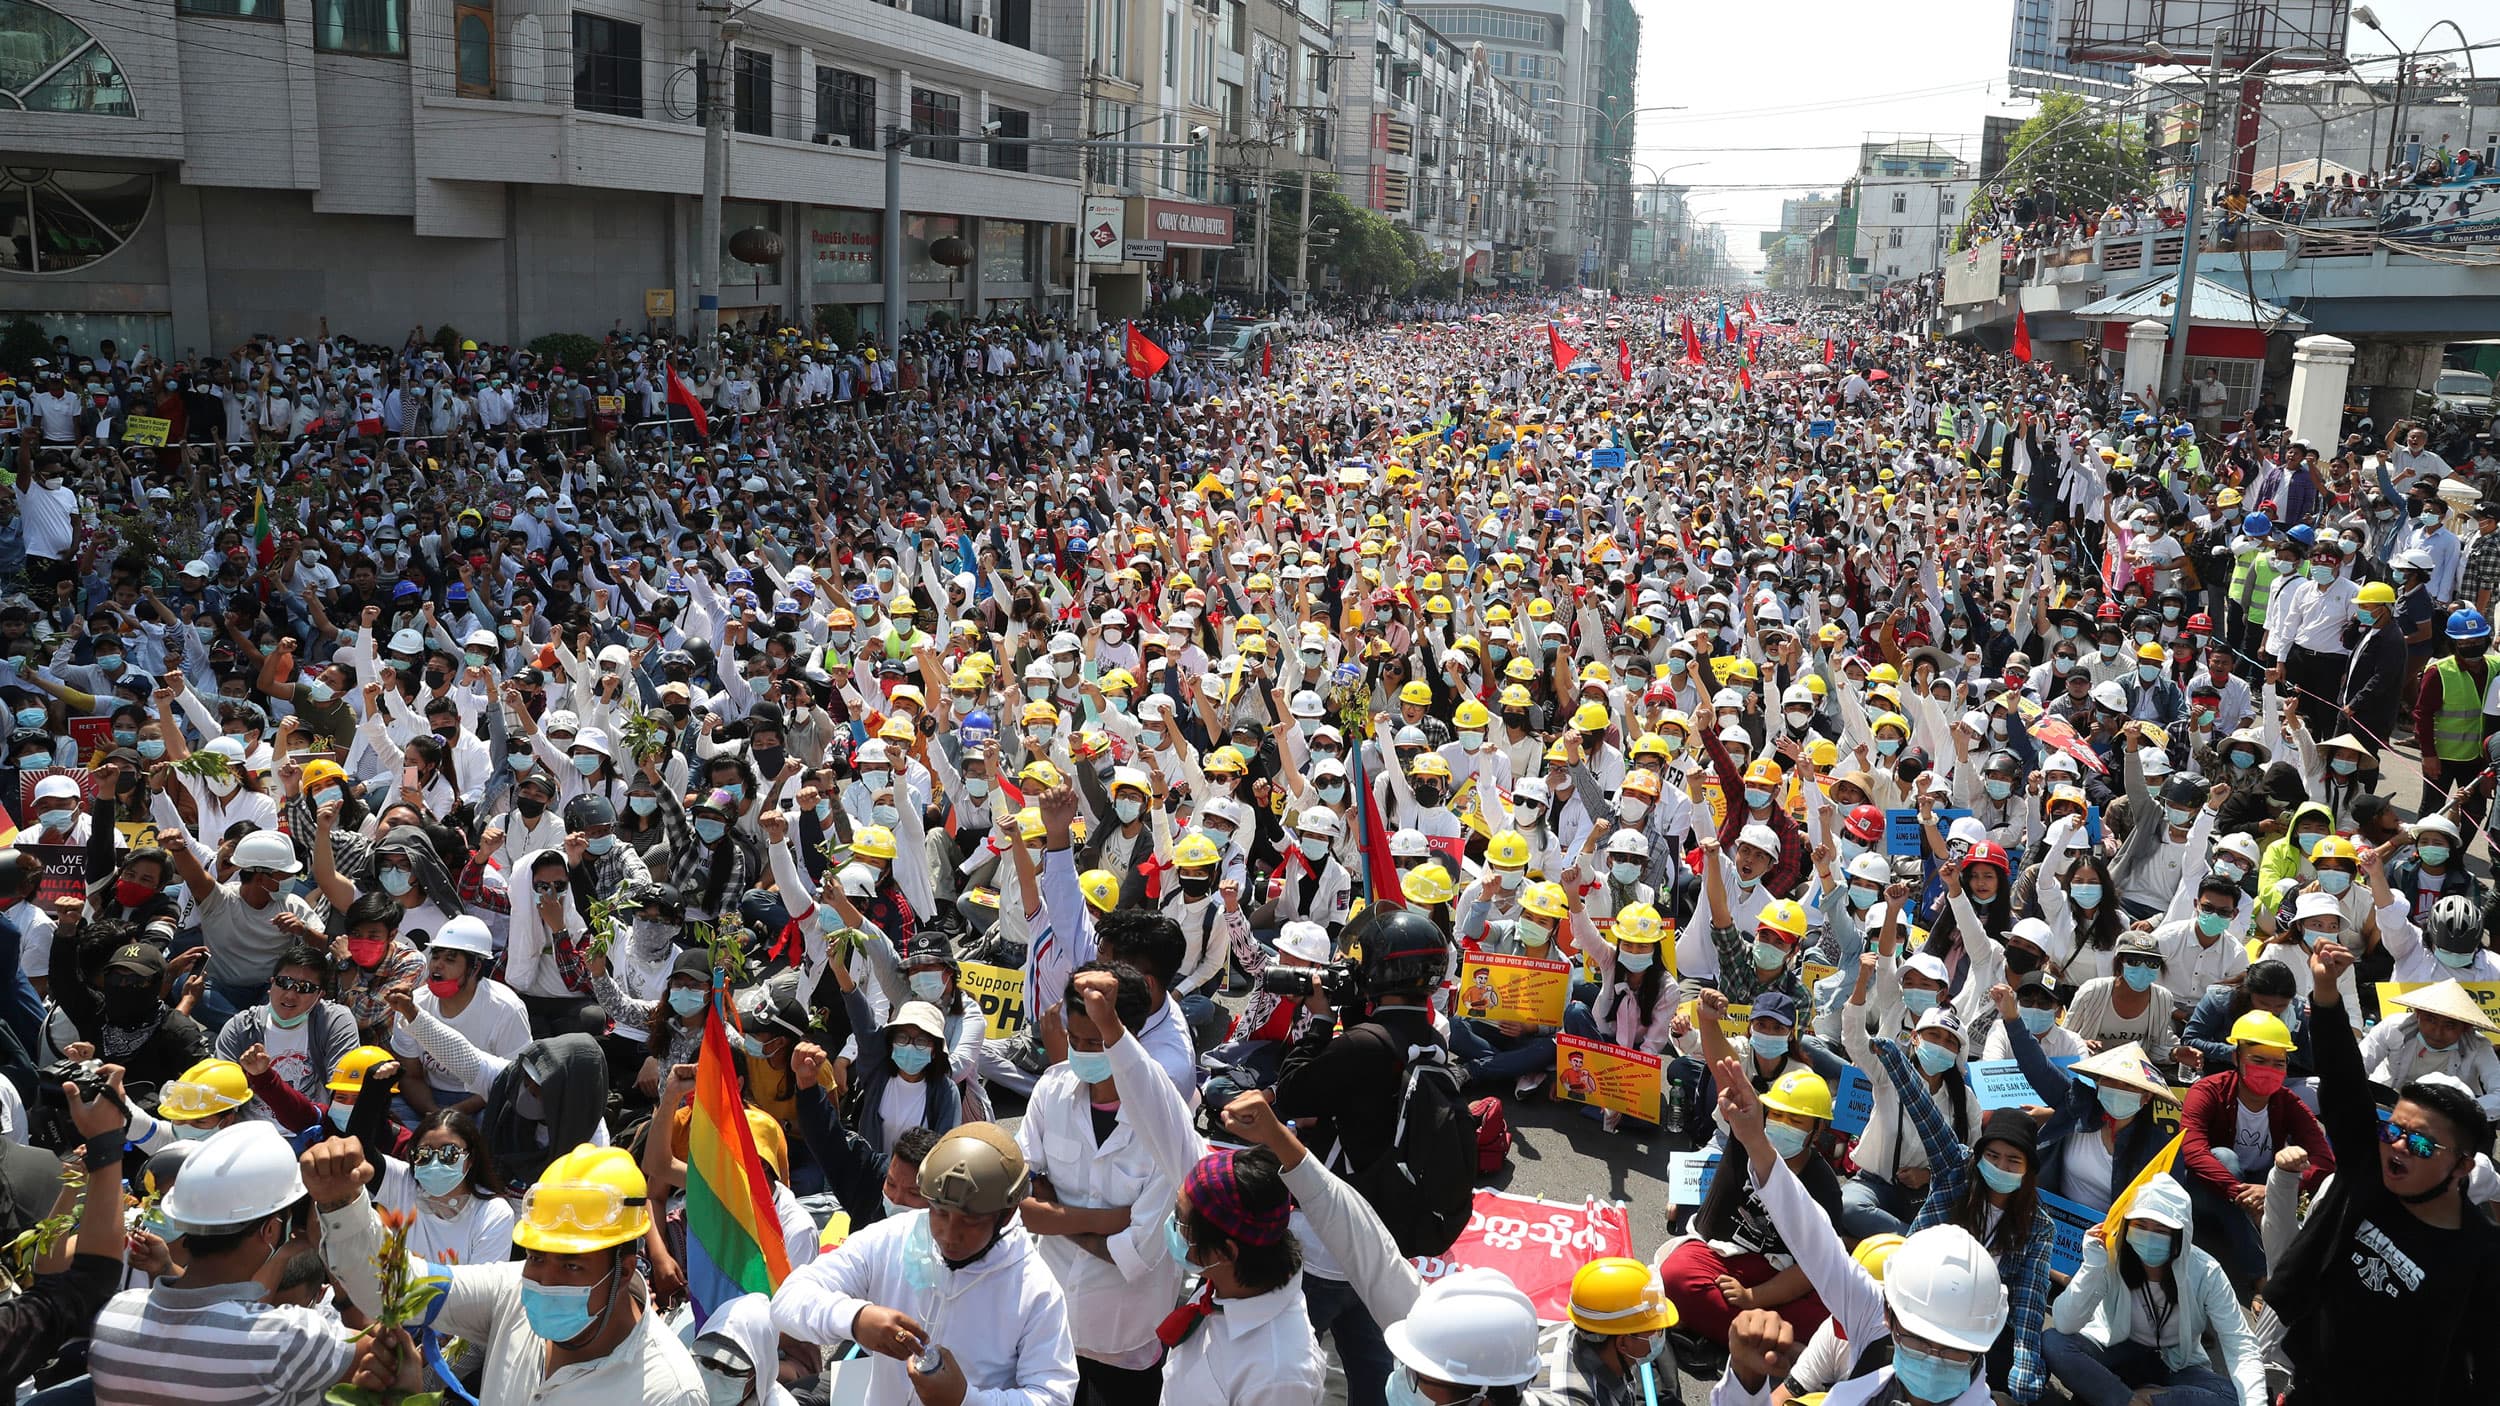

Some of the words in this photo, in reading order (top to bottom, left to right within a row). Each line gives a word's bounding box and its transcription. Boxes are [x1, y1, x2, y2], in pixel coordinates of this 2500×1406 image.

[1157, 212, 1178, 231] OWAY
[1179, 214, 1204, 233] GRAND
[1205, 217, 1227, 236] HOTEL
[812, 230, 848, 245] Pacific
[1126, 243, 1144, 251] OWAY
[1145, 244, 1162, 252] HOTEL
[1429, 839, 1448, 849] Our
[61, 855, 83, 865] WE
[45, 865, 76, 875] NOT
[966, 971, 1024, 993] Support
[1987, 1083, 2006, 1092] AUNG
[2006, 1082, 2020, 1091] SAN
[1848, 1099, 1867, 1112] AUNG
[1684, 1177, 1702, 1186] AUNG
[2056, 1235, 2071, 1249] SAN
[2351, 1252, 2364, 1265] 19
[2354, 1219, 2426, 1291] YANKEES
[2385, 1282, 2399, 1298] 03
